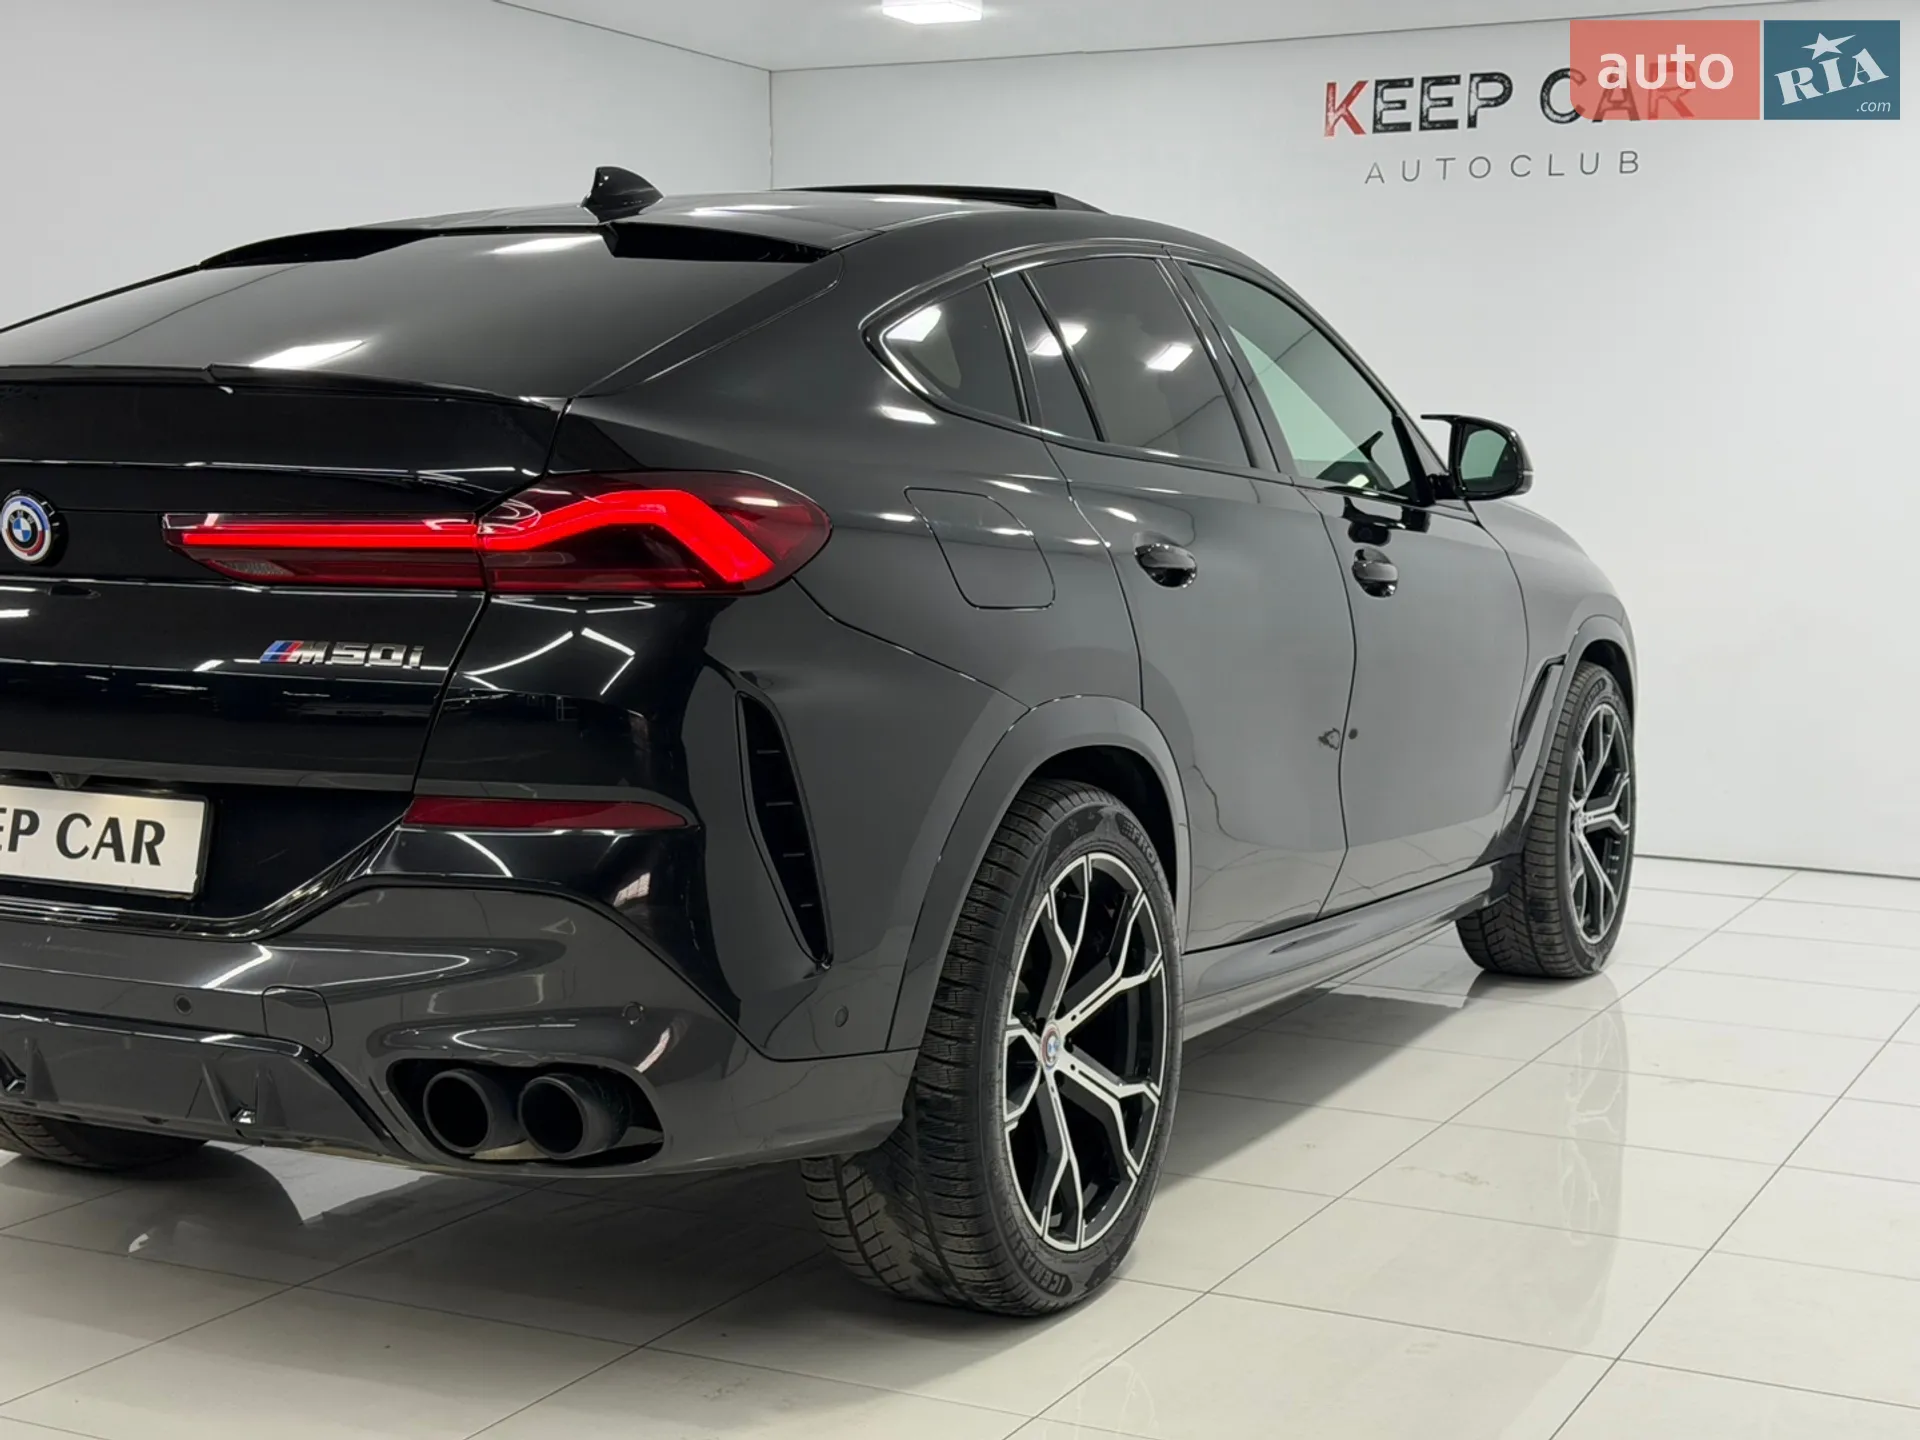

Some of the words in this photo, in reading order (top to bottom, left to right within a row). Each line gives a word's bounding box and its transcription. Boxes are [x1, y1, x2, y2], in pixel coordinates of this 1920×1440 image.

[1325, 71, 1513, 136] KEEP
[1540, 62, 1696, 124] CAR
[1365, 150, 1639, 184] AUTOCLUB
[56, 812, 166, 866] CAR
